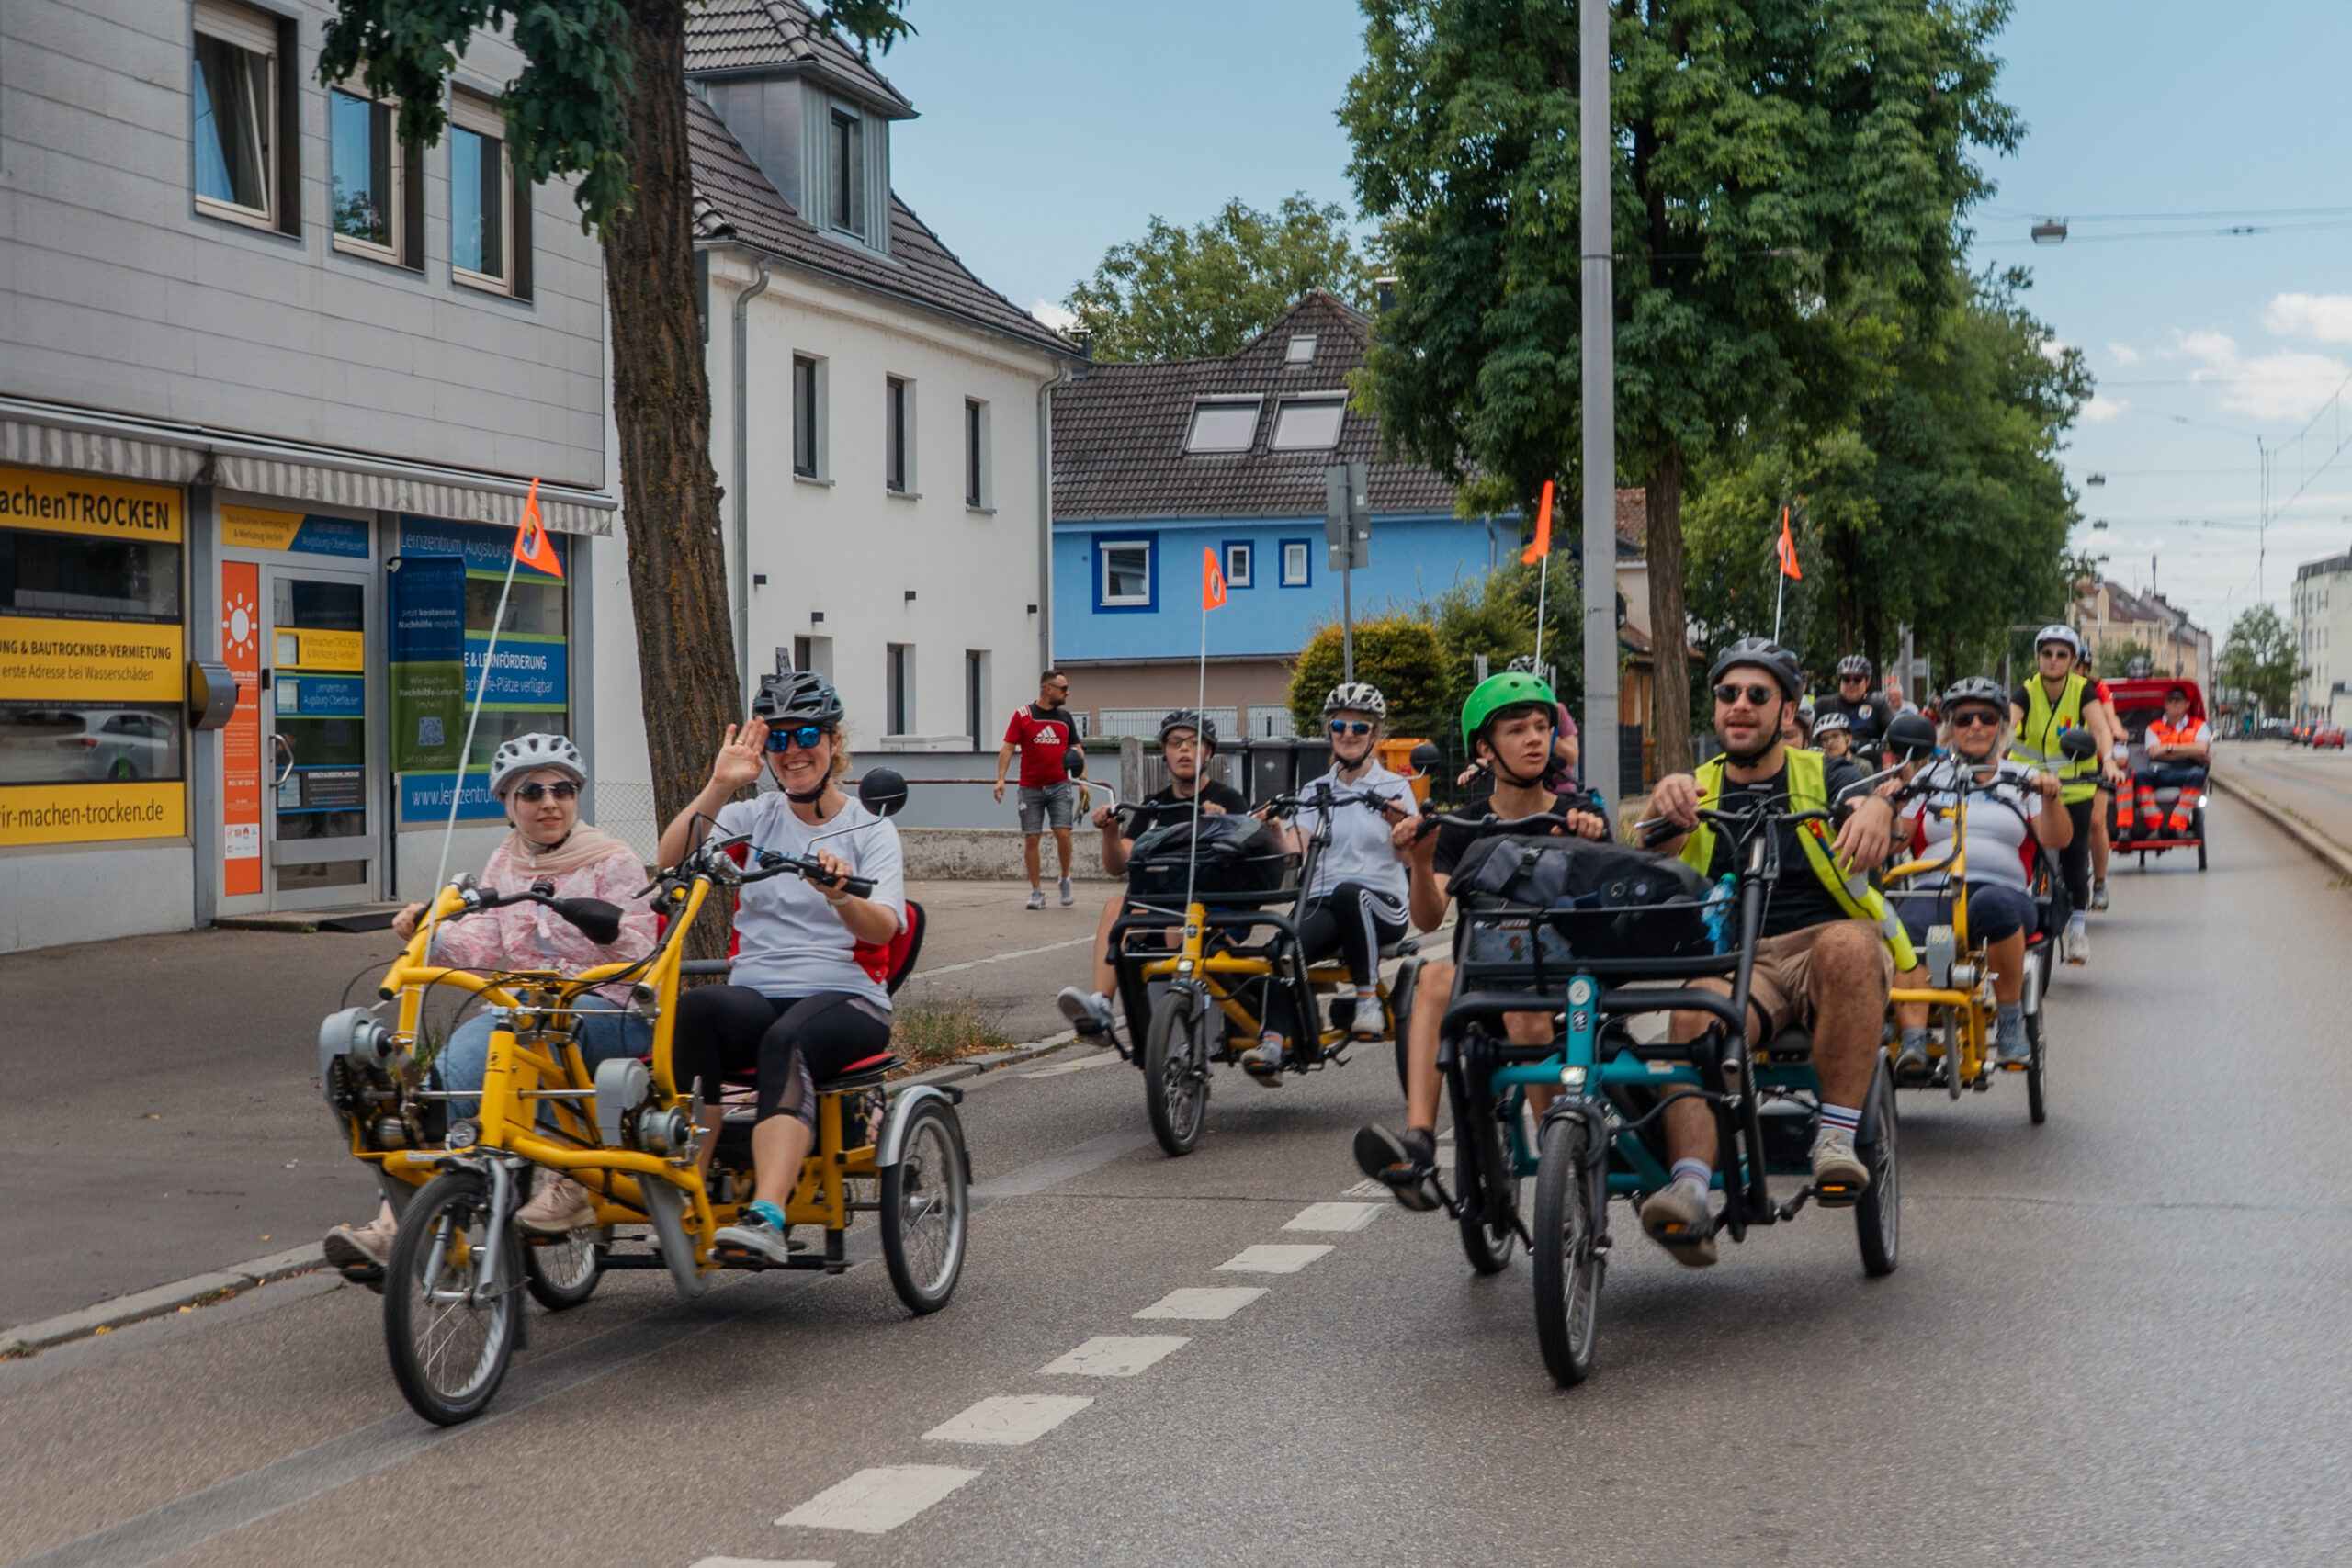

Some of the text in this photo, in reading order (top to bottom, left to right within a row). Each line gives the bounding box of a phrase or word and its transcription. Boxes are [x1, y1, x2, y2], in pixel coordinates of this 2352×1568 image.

[401, 532, 462, 552] Lernzentrum
[398, 619, 433, 629] Nachhilfe
[21, 640, 28, 655] &
[31, 641, 172, 660] BAUTROCKNER-VERMIETUNG
[470, 652, 478, 668] &
[2, 664, 154, 682] erste Adresse bei Wasserschäden
[520, 677, 553, 696] verfügbar
[1033, 737, 1060, 745] adidas
[0, 797, 164, 829] ir-machen-trocken.de
